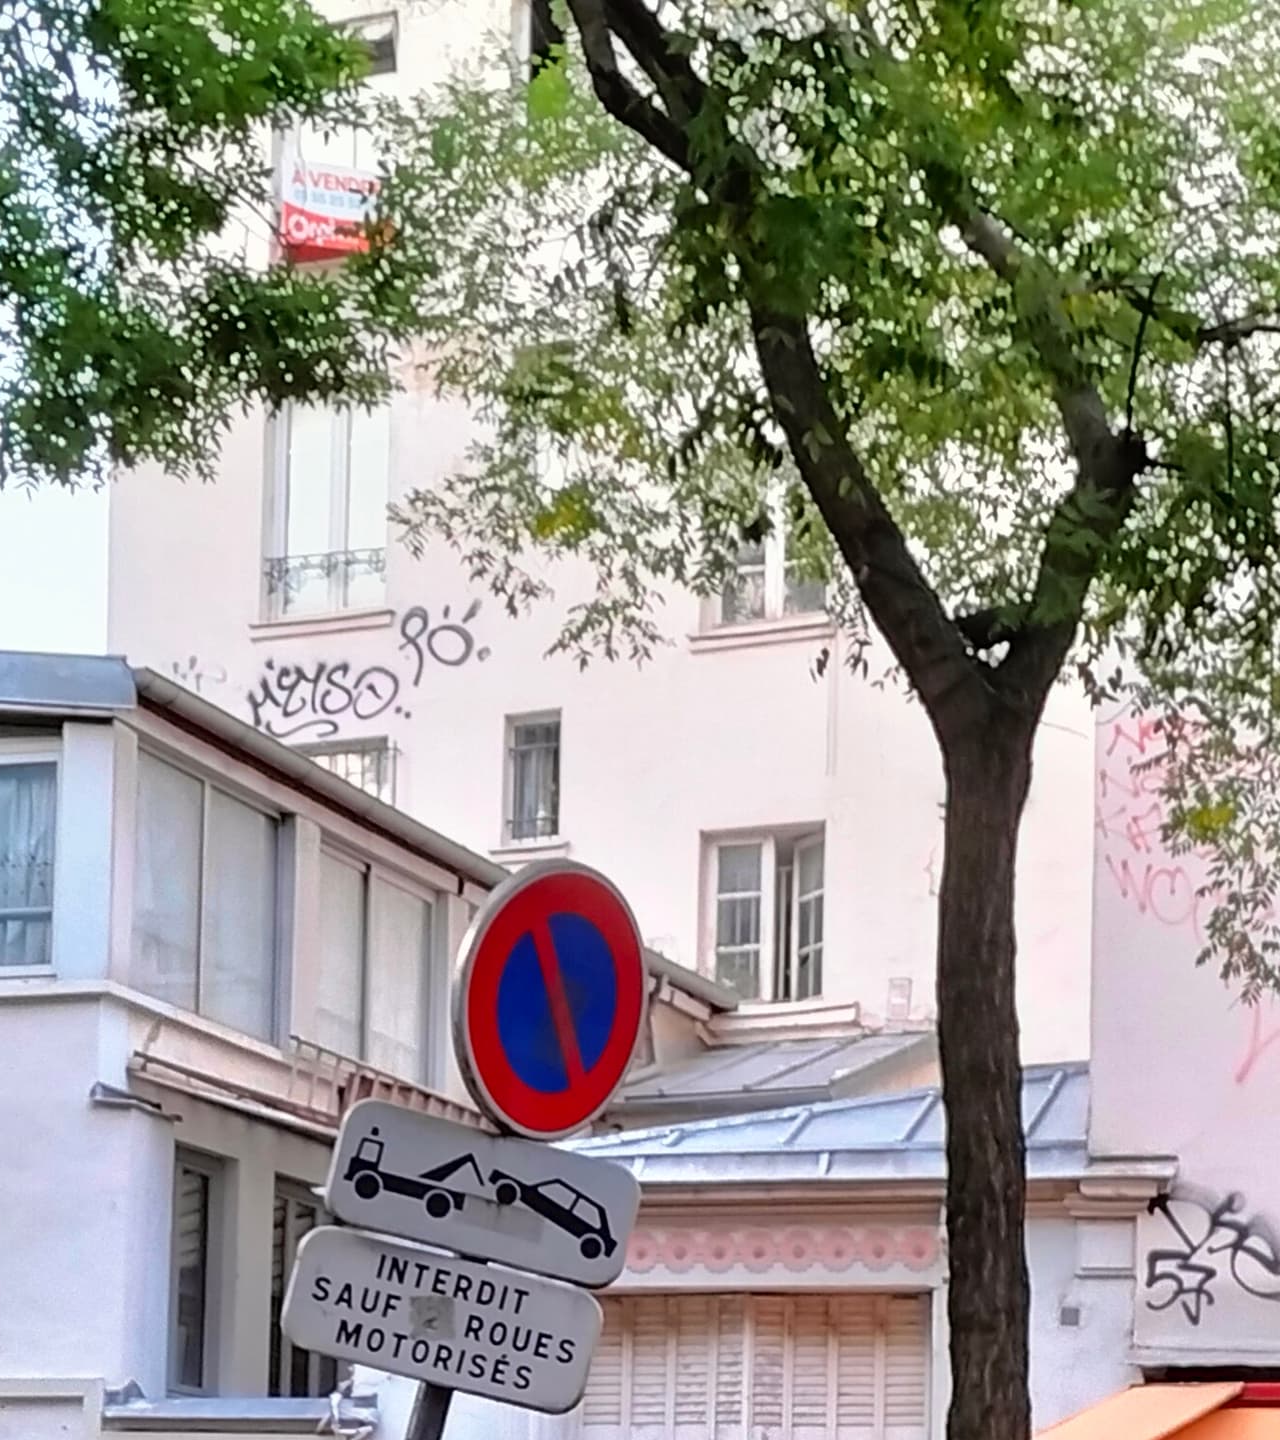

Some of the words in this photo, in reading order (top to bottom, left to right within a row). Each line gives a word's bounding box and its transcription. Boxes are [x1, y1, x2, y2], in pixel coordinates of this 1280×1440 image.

[308, 171, 382, 194] VENDR
[376, 1253, 530, 1315] INTERDIT
[311, 1277, 402, 1318] SAUF
[464, 1314, 576, 1364] ROUES
[335, 1319, 534, 1390] MOTORISÉS
